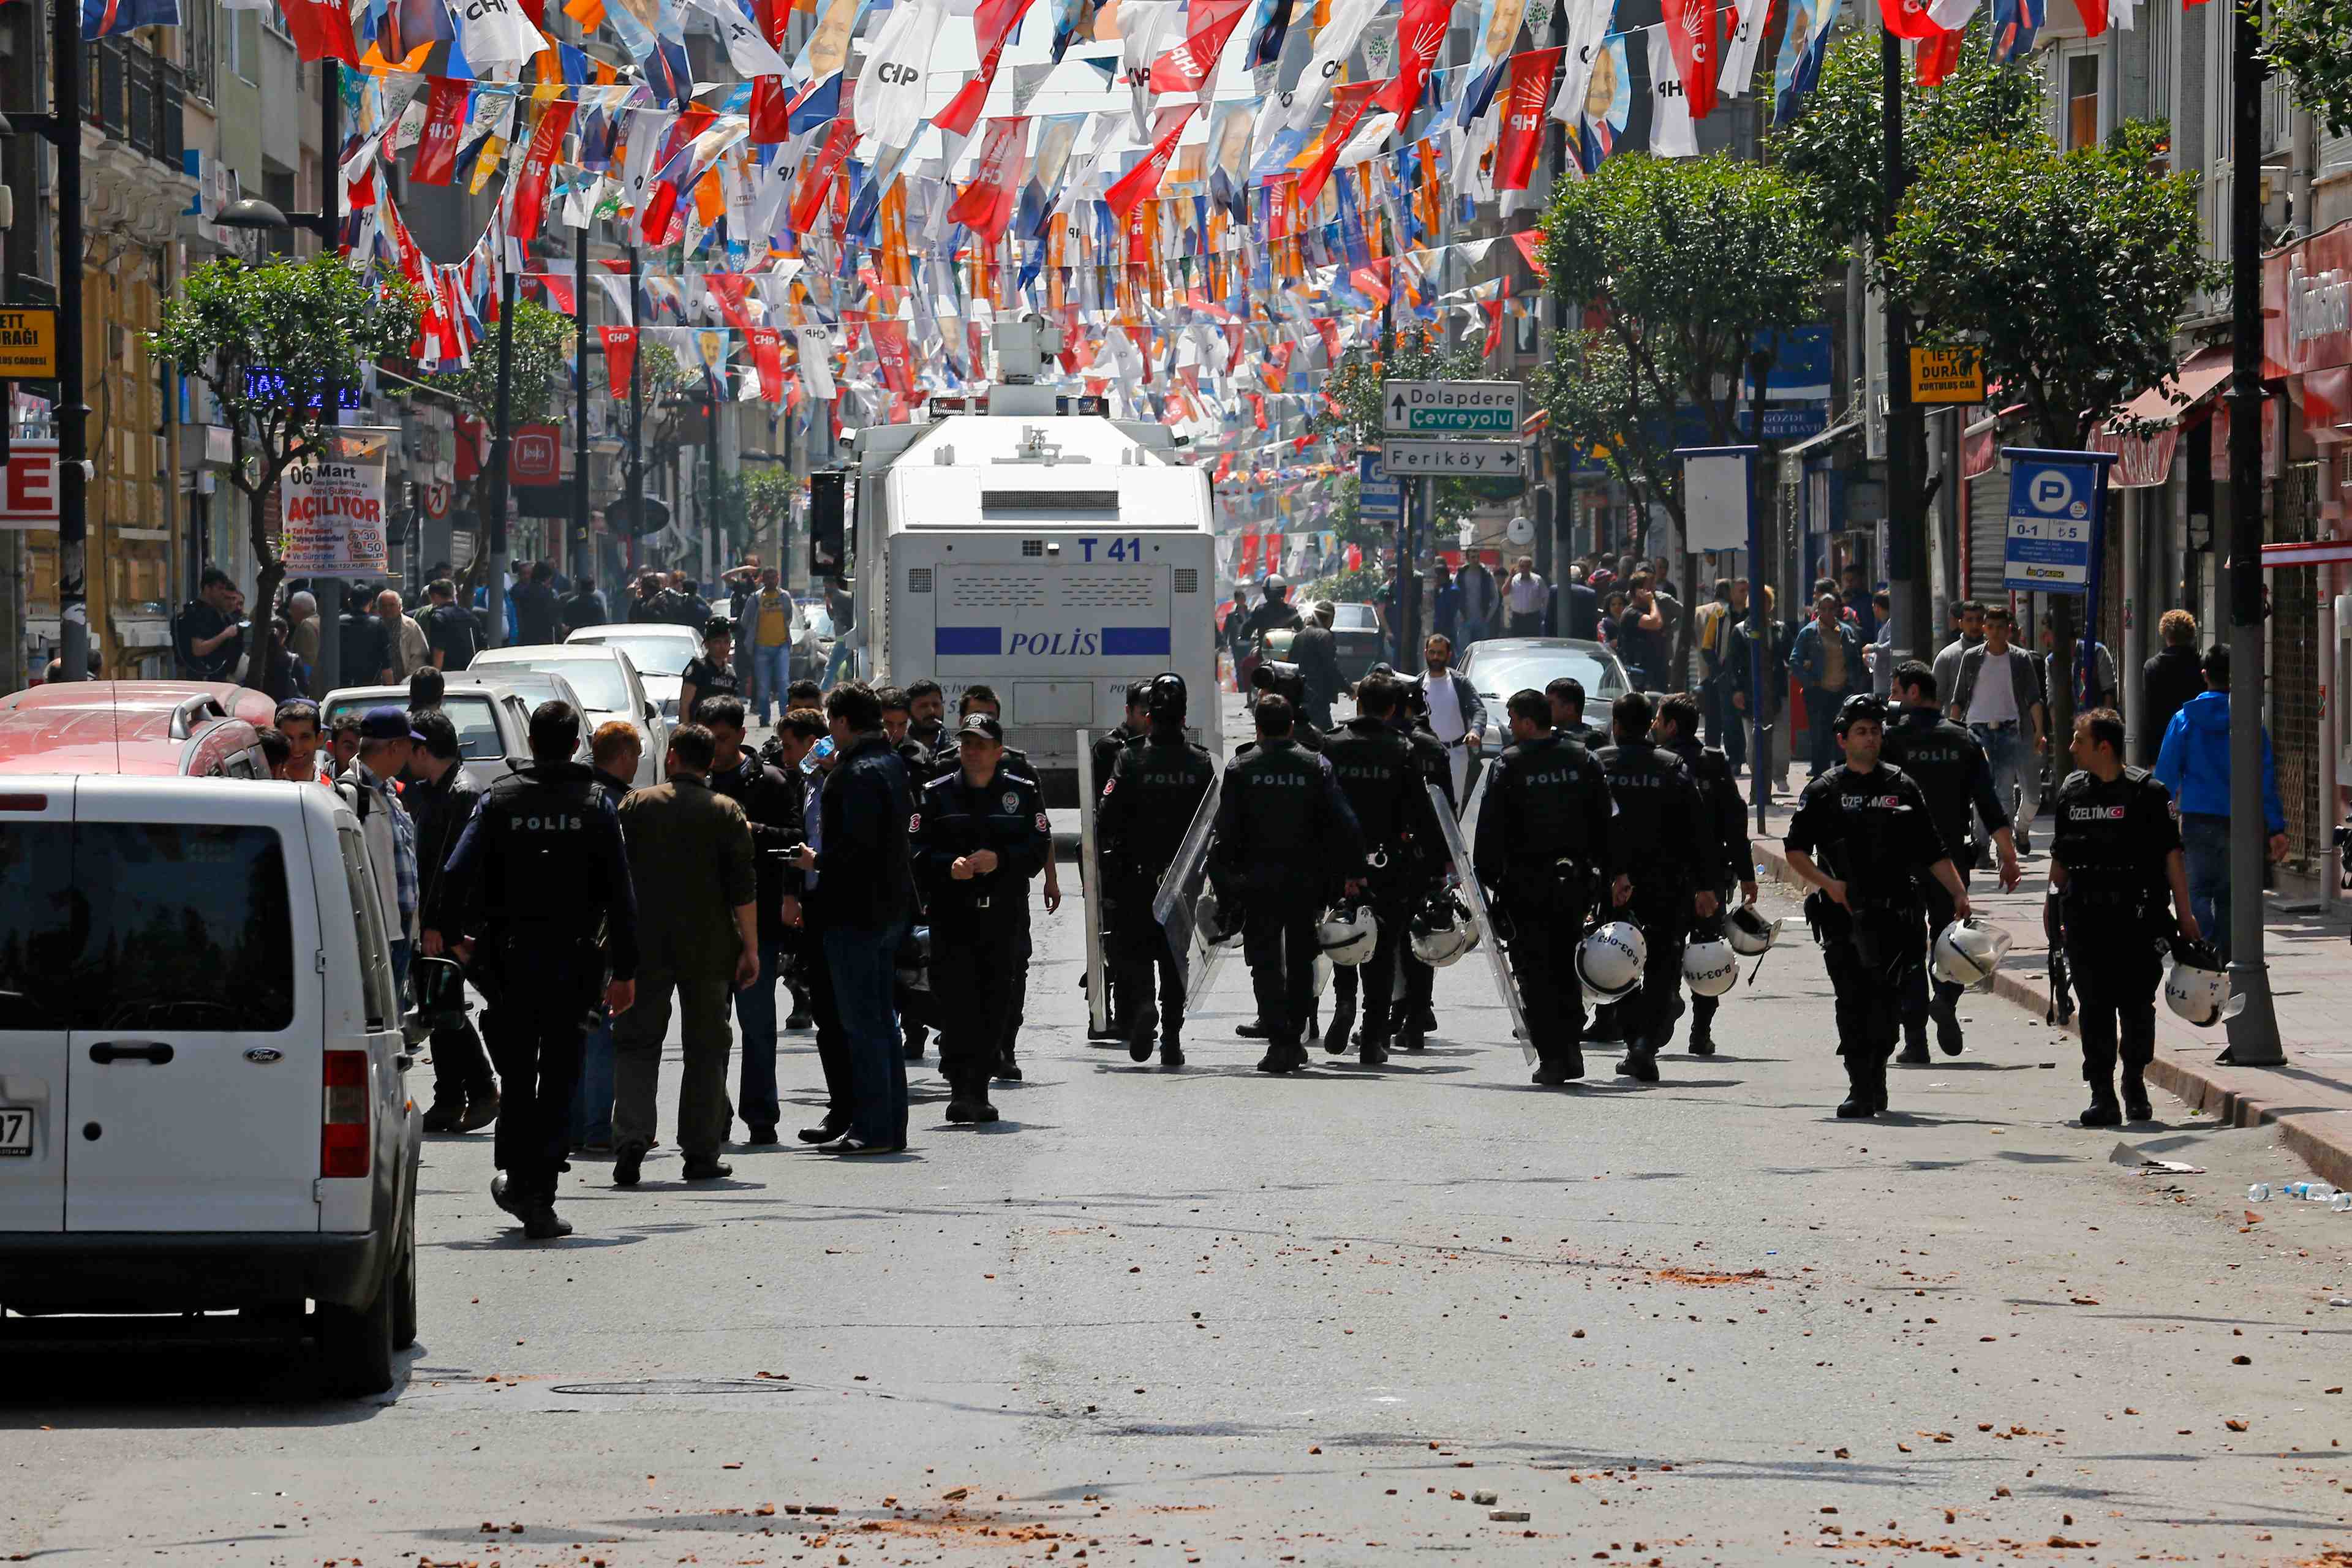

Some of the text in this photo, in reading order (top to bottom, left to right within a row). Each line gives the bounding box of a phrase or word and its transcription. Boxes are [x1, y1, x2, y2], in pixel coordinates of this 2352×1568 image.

[0, 328, 38, 345] RAĞI
[609, 333, 629, 342] CHP
[753, 335, 775, 345] CHP
[1919, 382, 1958, 392] KURTULUŞ
[1411, 389, 1515, 408] Dolapdere
[1412, 410, 1510, 428] Çevreyolu
[1763, 412, 1804, 423] GÖZDE
[1393, 451, 1486, 469] Feriköy
[291, 464, 356, 484] 06 Mart
[2039, 480, 2064, 502] P
[288, 496, 380, 526] AÇILIYOR
[363, 532, 376, 540] 30
[2017, 524, 2038, 536] 0-1
[367, 543, 381, 552] 50
[1079, 537, 1140, 562] T 41
[1007, 627, 1098, 655] POLİS
[253, 1050, 275, 1060] Ford
